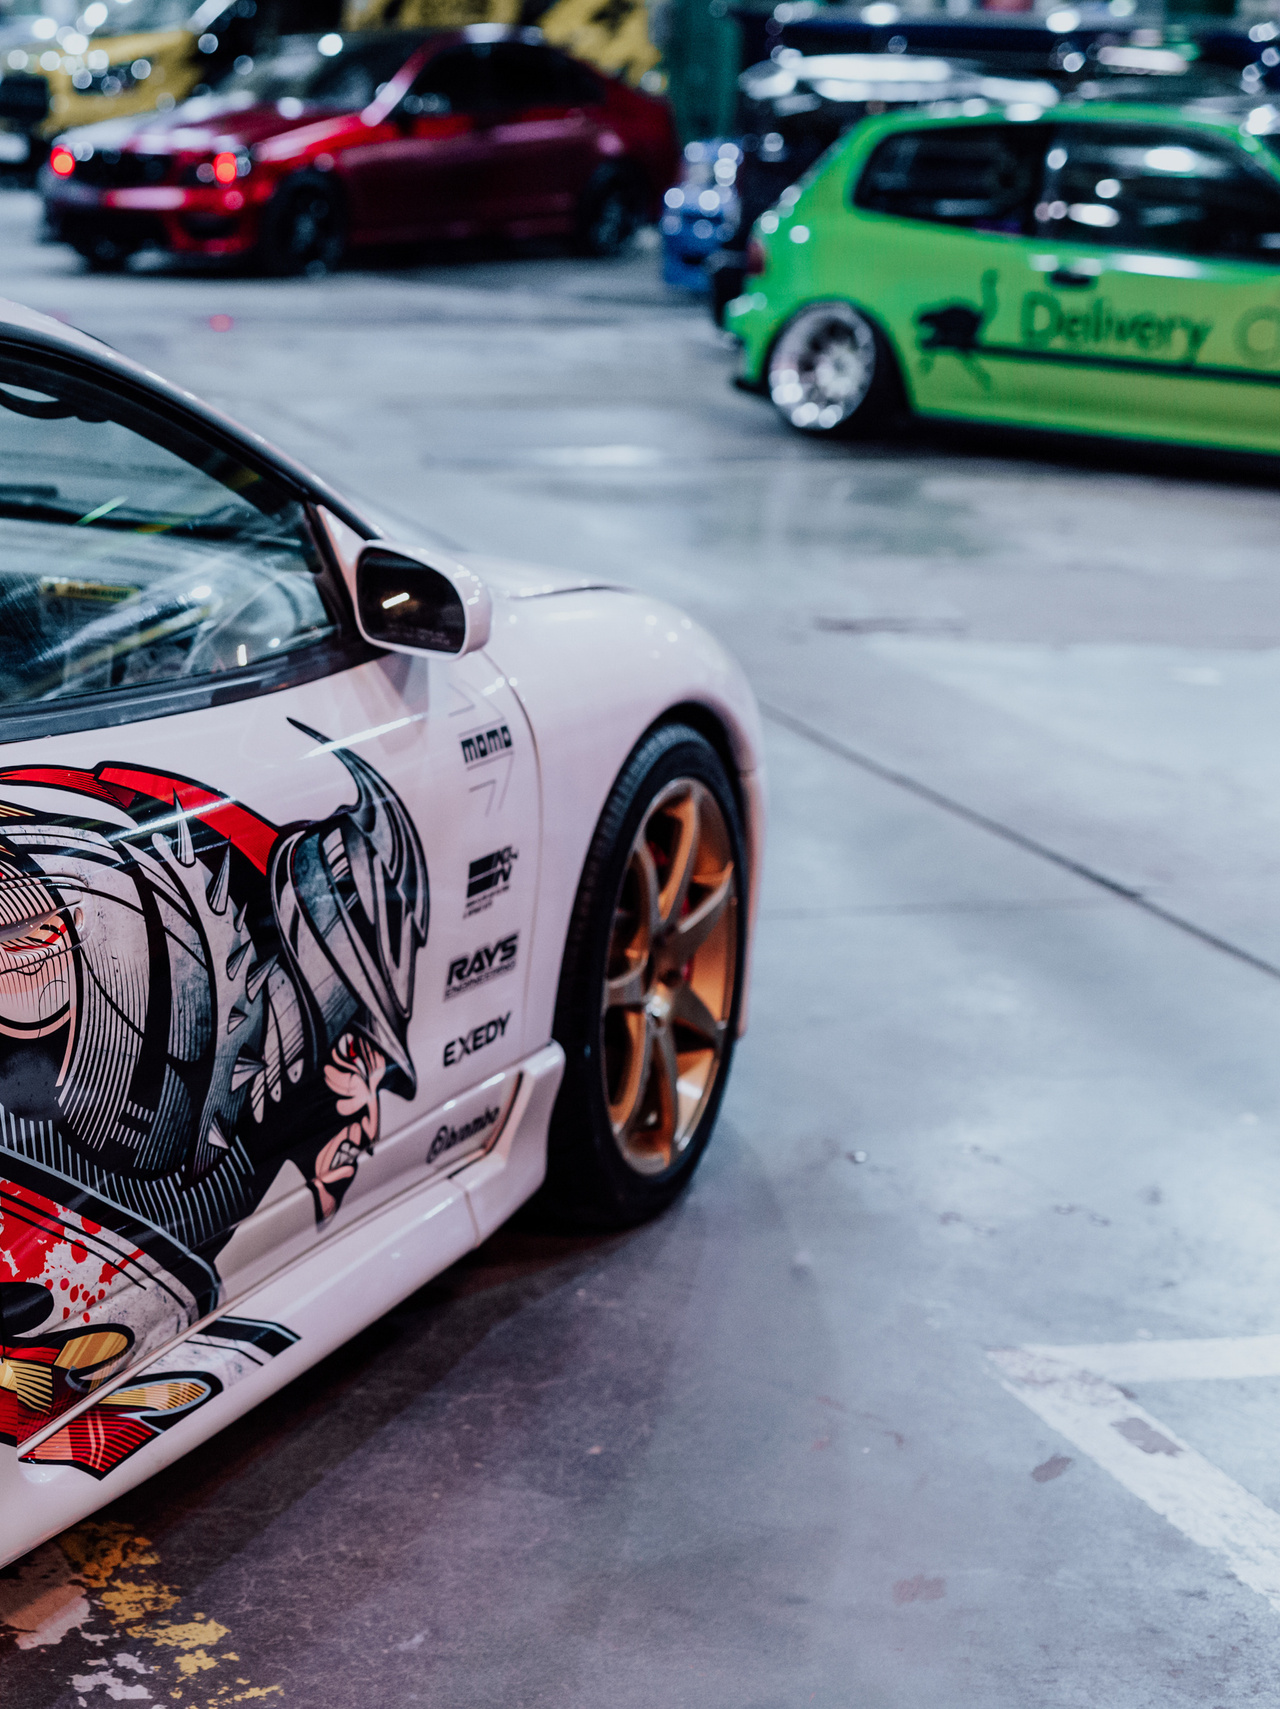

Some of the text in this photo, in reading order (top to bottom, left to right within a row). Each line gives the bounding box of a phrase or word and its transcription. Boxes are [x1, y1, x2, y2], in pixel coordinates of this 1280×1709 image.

[1021, 291, 1213, 368] Delivery
[447, 932, 519, 986] RAYS
[443, 1011, 511, 1067] EXEDY
